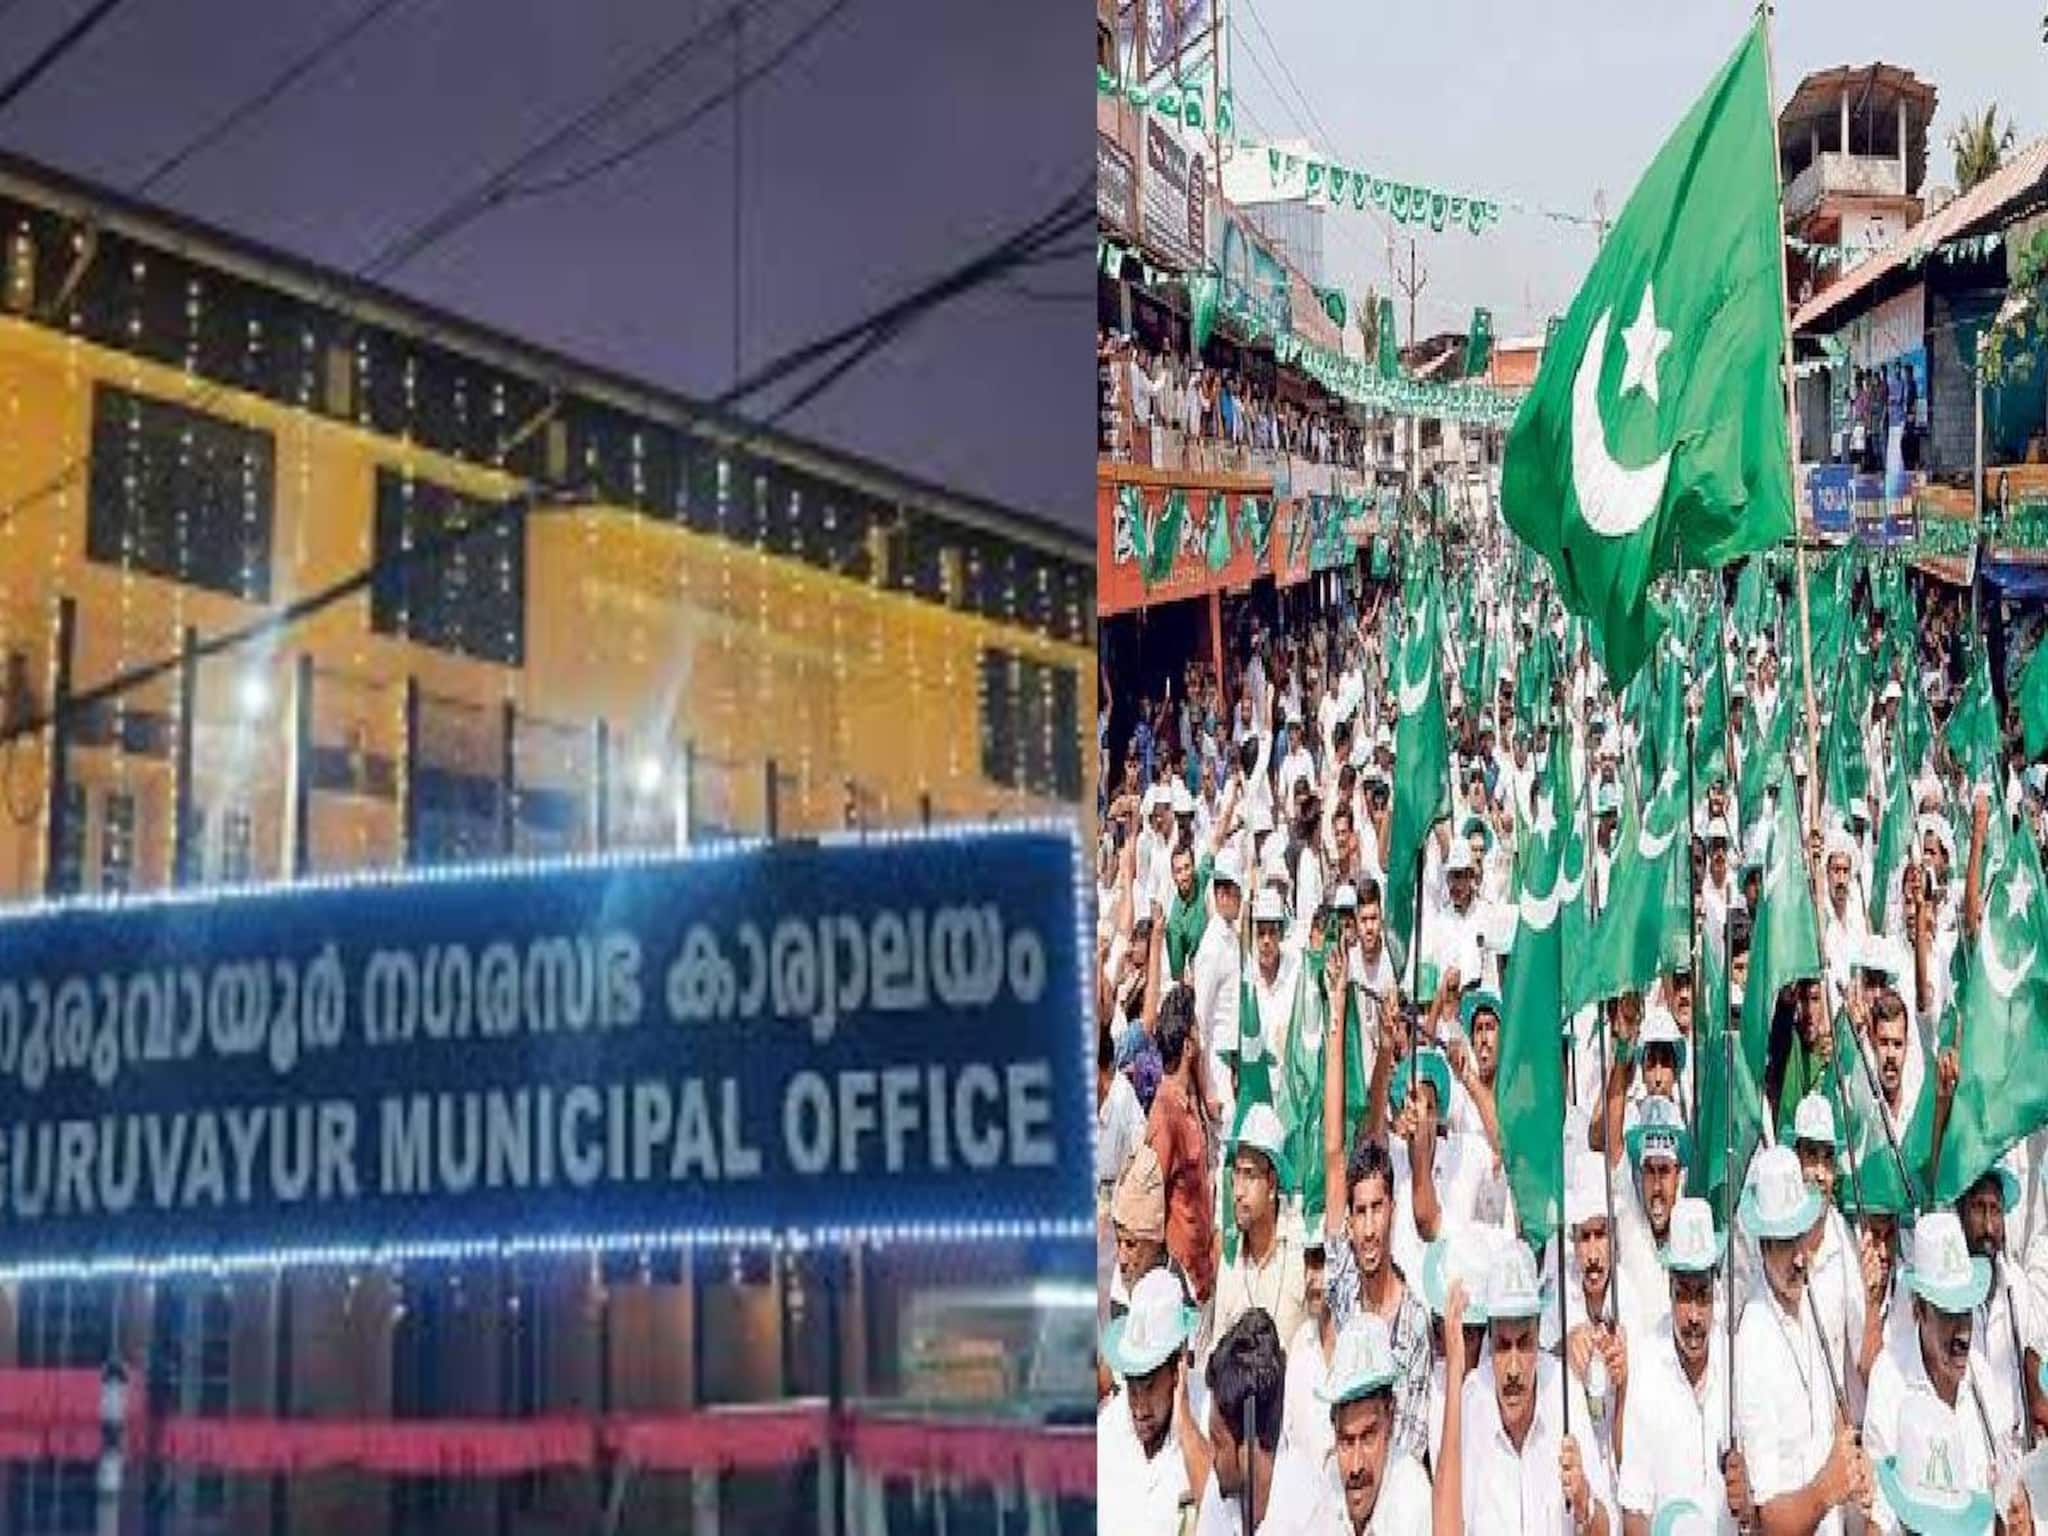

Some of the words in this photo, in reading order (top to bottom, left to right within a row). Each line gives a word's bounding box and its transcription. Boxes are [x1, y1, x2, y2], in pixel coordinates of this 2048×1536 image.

[364, 932, 643, 1047] നഗരസഭ
[665, 901, 1047, 1042] കാര്യാലയം
[0, 1099, 358, 1215] URUVAYUR
[380, 1077, 762, 1196] MUNICIPAL
[783, 1061, 1057, 1175] OFFICE
